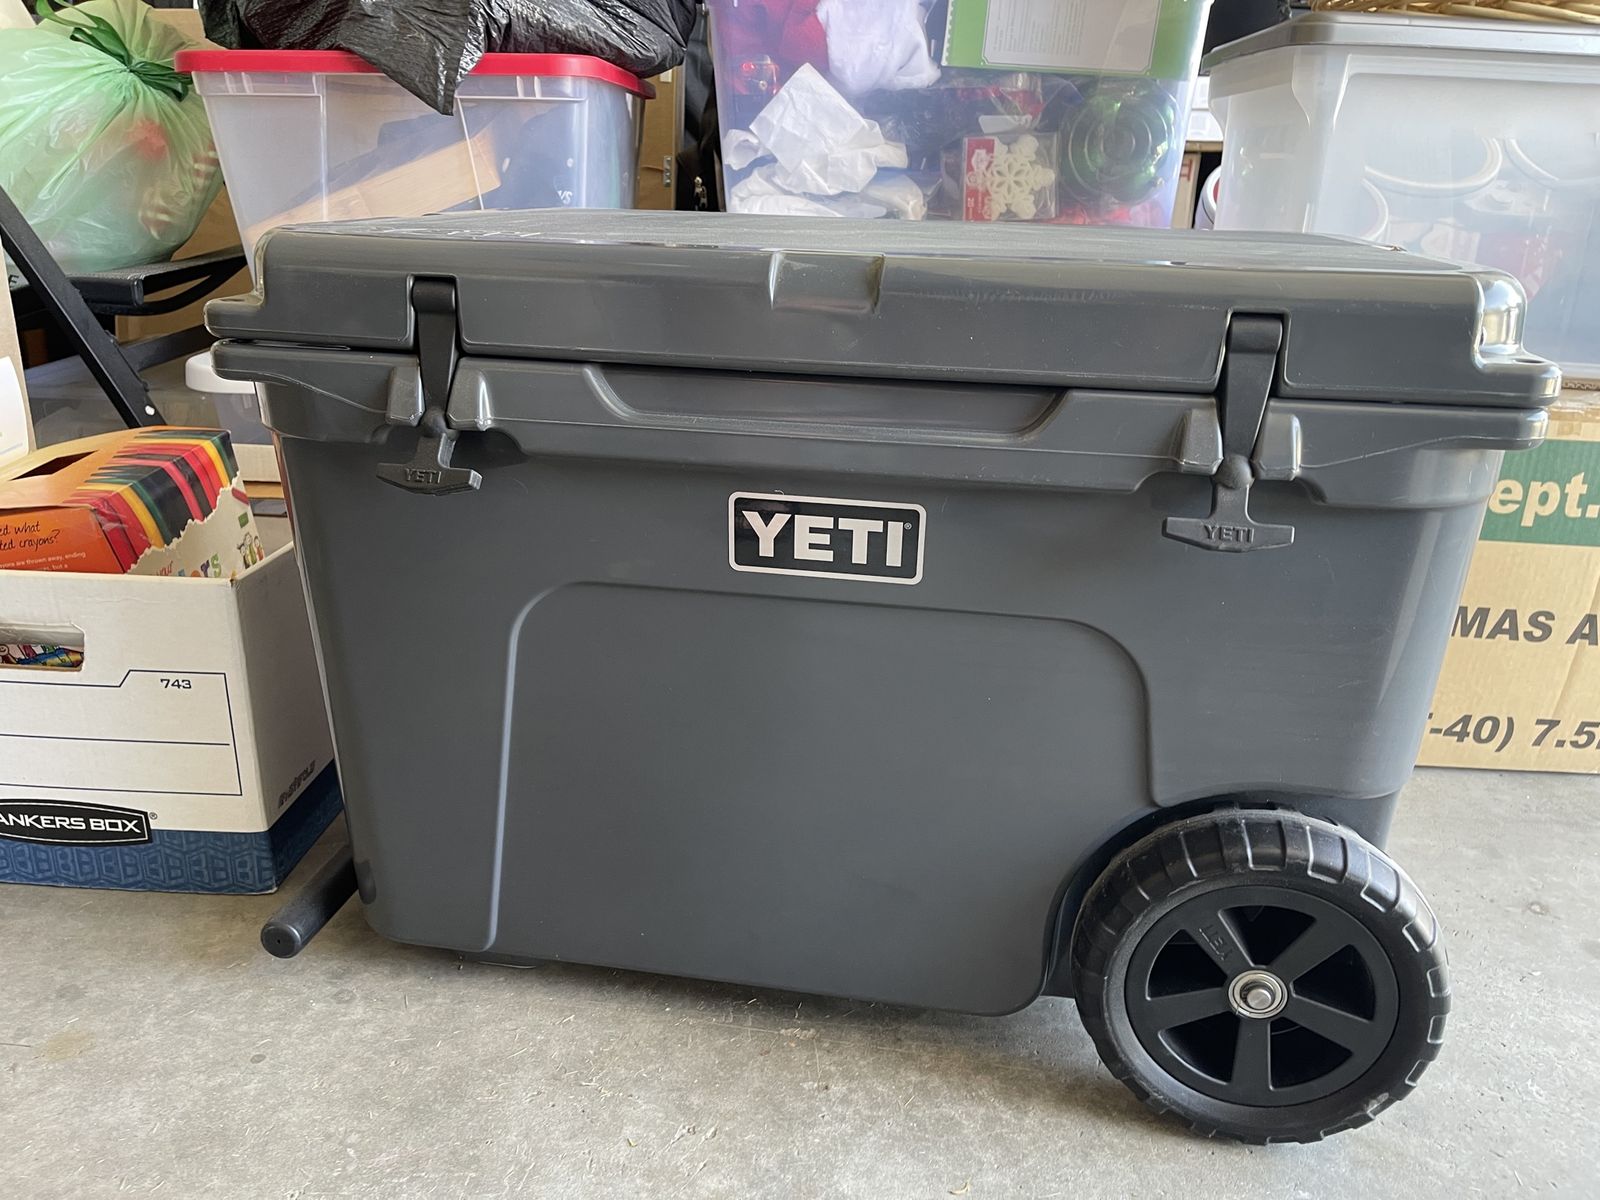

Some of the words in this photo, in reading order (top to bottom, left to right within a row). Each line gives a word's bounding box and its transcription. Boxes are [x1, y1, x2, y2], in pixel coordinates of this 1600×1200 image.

[406, 468, 441, 484] YETI
[1488, 472, 1600, 527] ept.
[14, 520, 41, 535] what
[1203, 524, 1255, 544] YETI
[19, 529, 60, 551] crayons?
[742, 510, 904, 567] YETI
[64, 551, 86, 559] ending
[1565, 613, 1599, 646] A
[160, 678, 192, 689] 743
[1531, 718, 1600, 750] 7.5
[0, 813, 86, 830] ANKERS
[90, 818, 142, 834] BOX
